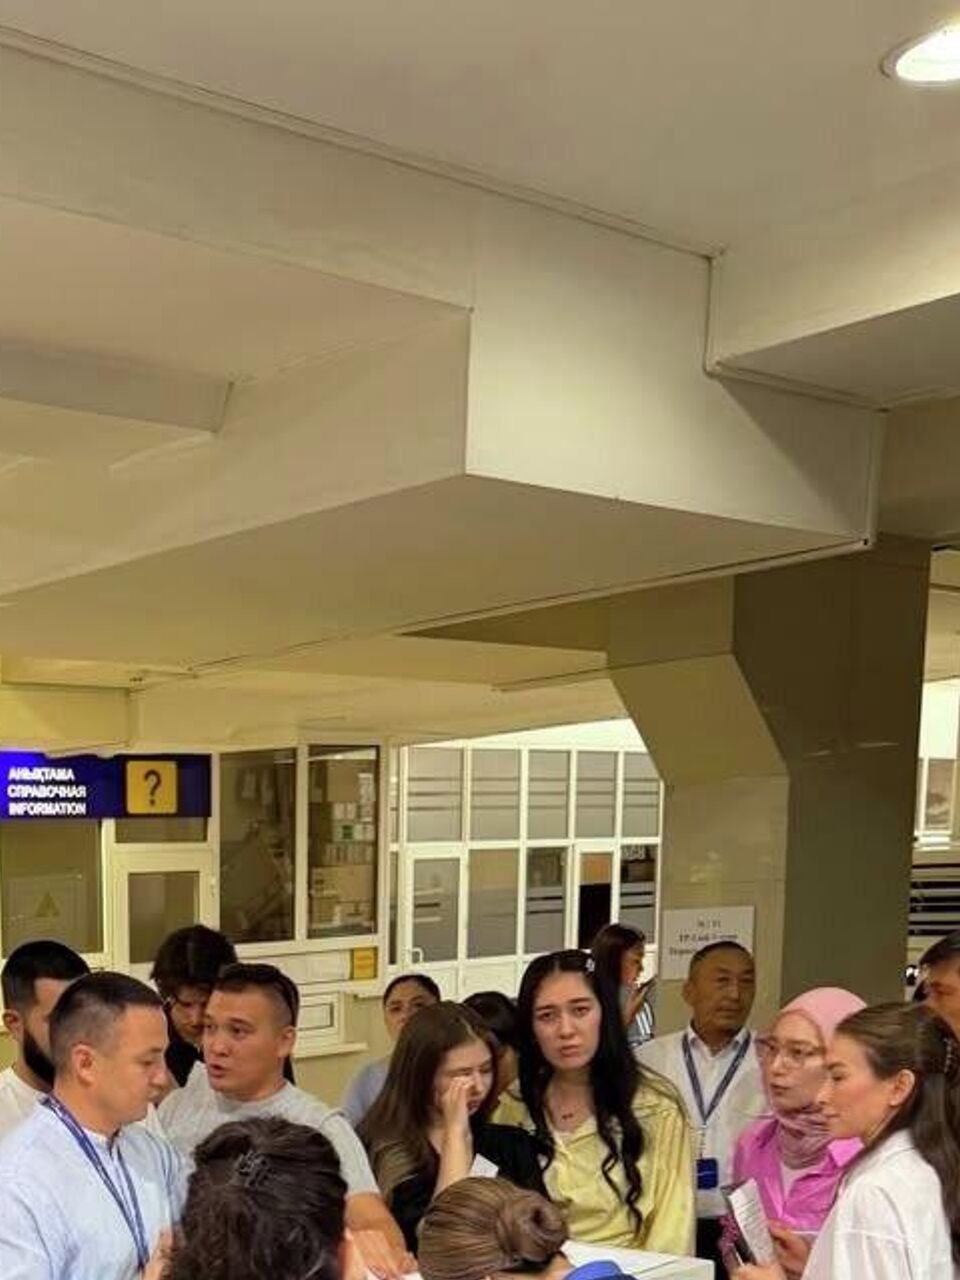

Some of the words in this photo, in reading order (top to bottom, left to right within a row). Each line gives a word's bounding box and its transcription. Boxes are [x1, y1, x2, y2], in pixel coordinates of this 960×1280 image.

[8, 767, 74, 783] АНЫҚТАМА
[7, 784, 87, 799] СПРАВОЧНАЯ
[8, 801, 87, 816] INFORMATION
